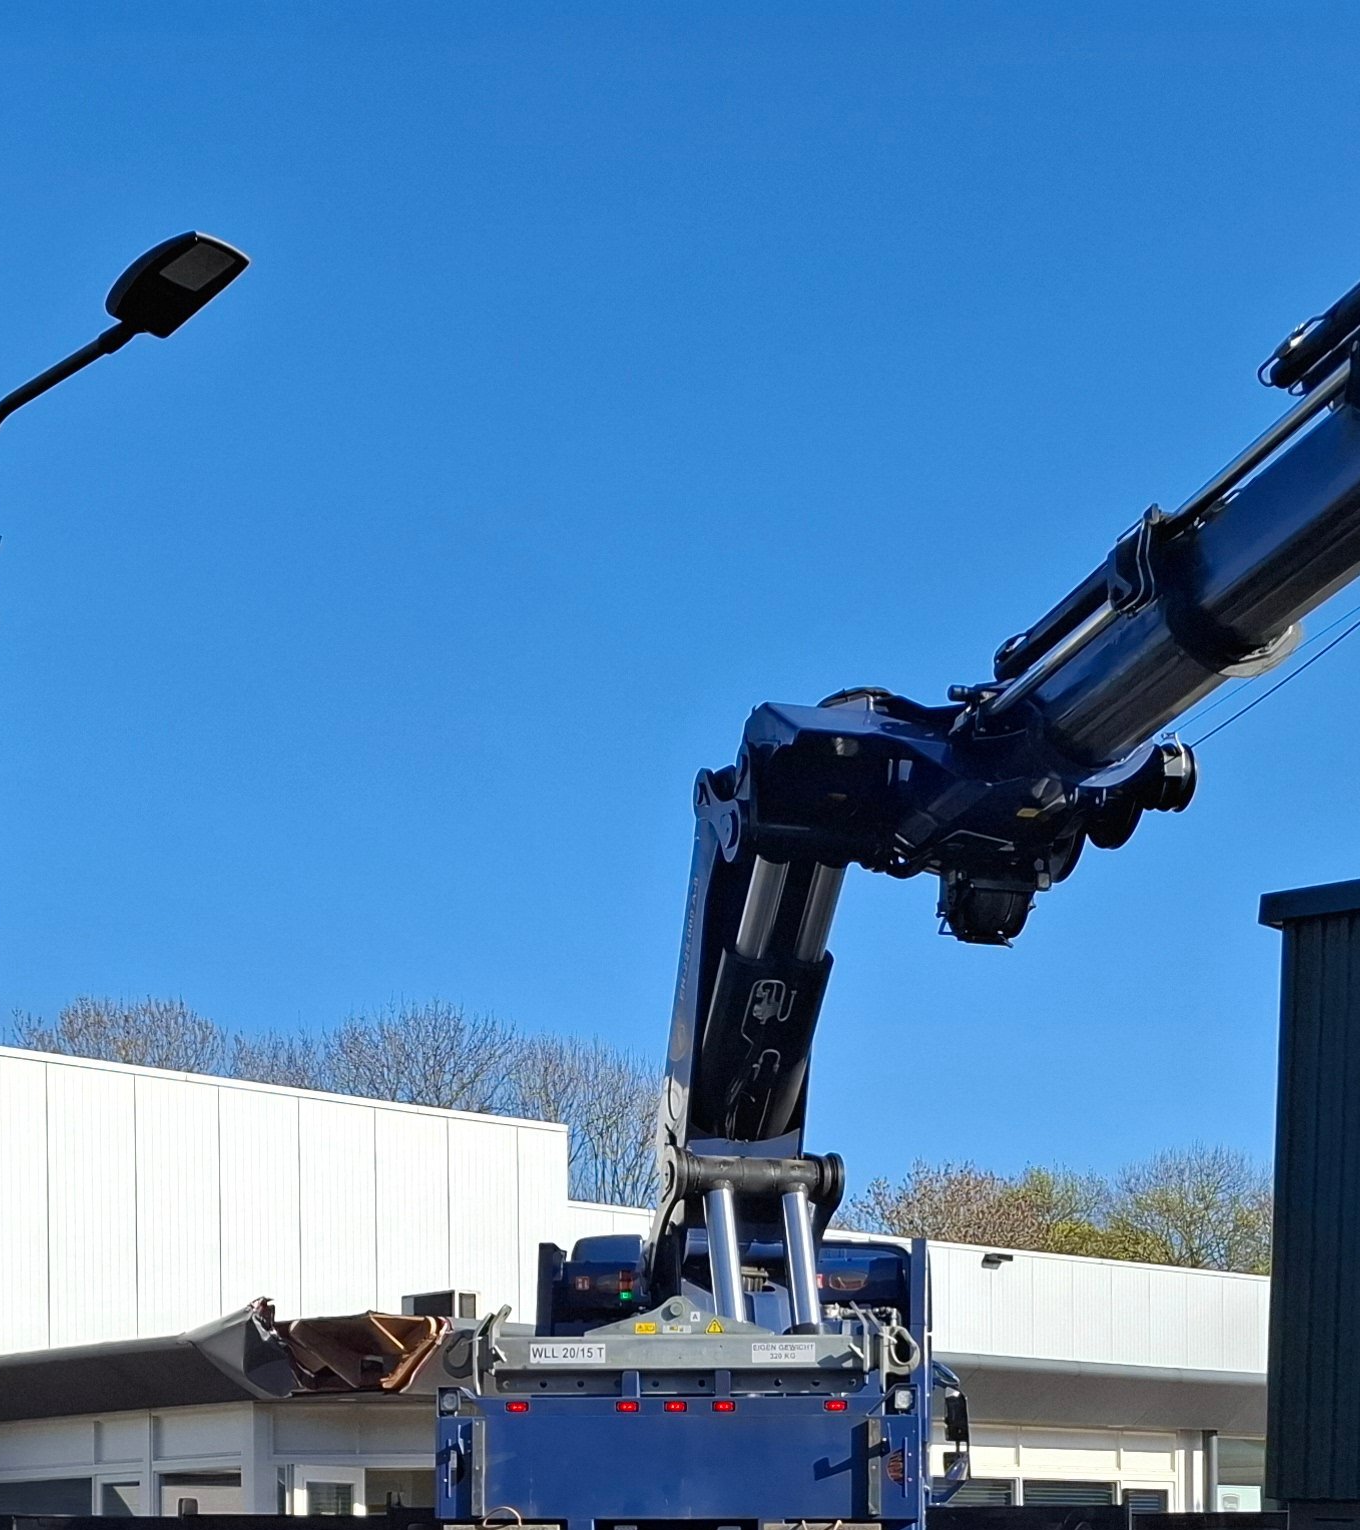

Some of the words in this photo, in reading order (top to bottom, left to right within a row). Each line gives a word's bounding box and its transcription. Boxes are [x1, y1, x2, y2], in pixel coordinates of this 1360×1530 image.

[531, 1347, 559, 1359] WLL
[562, 1347, 594, 1359] 20/15
[596, 1347, 605, 1359] T
